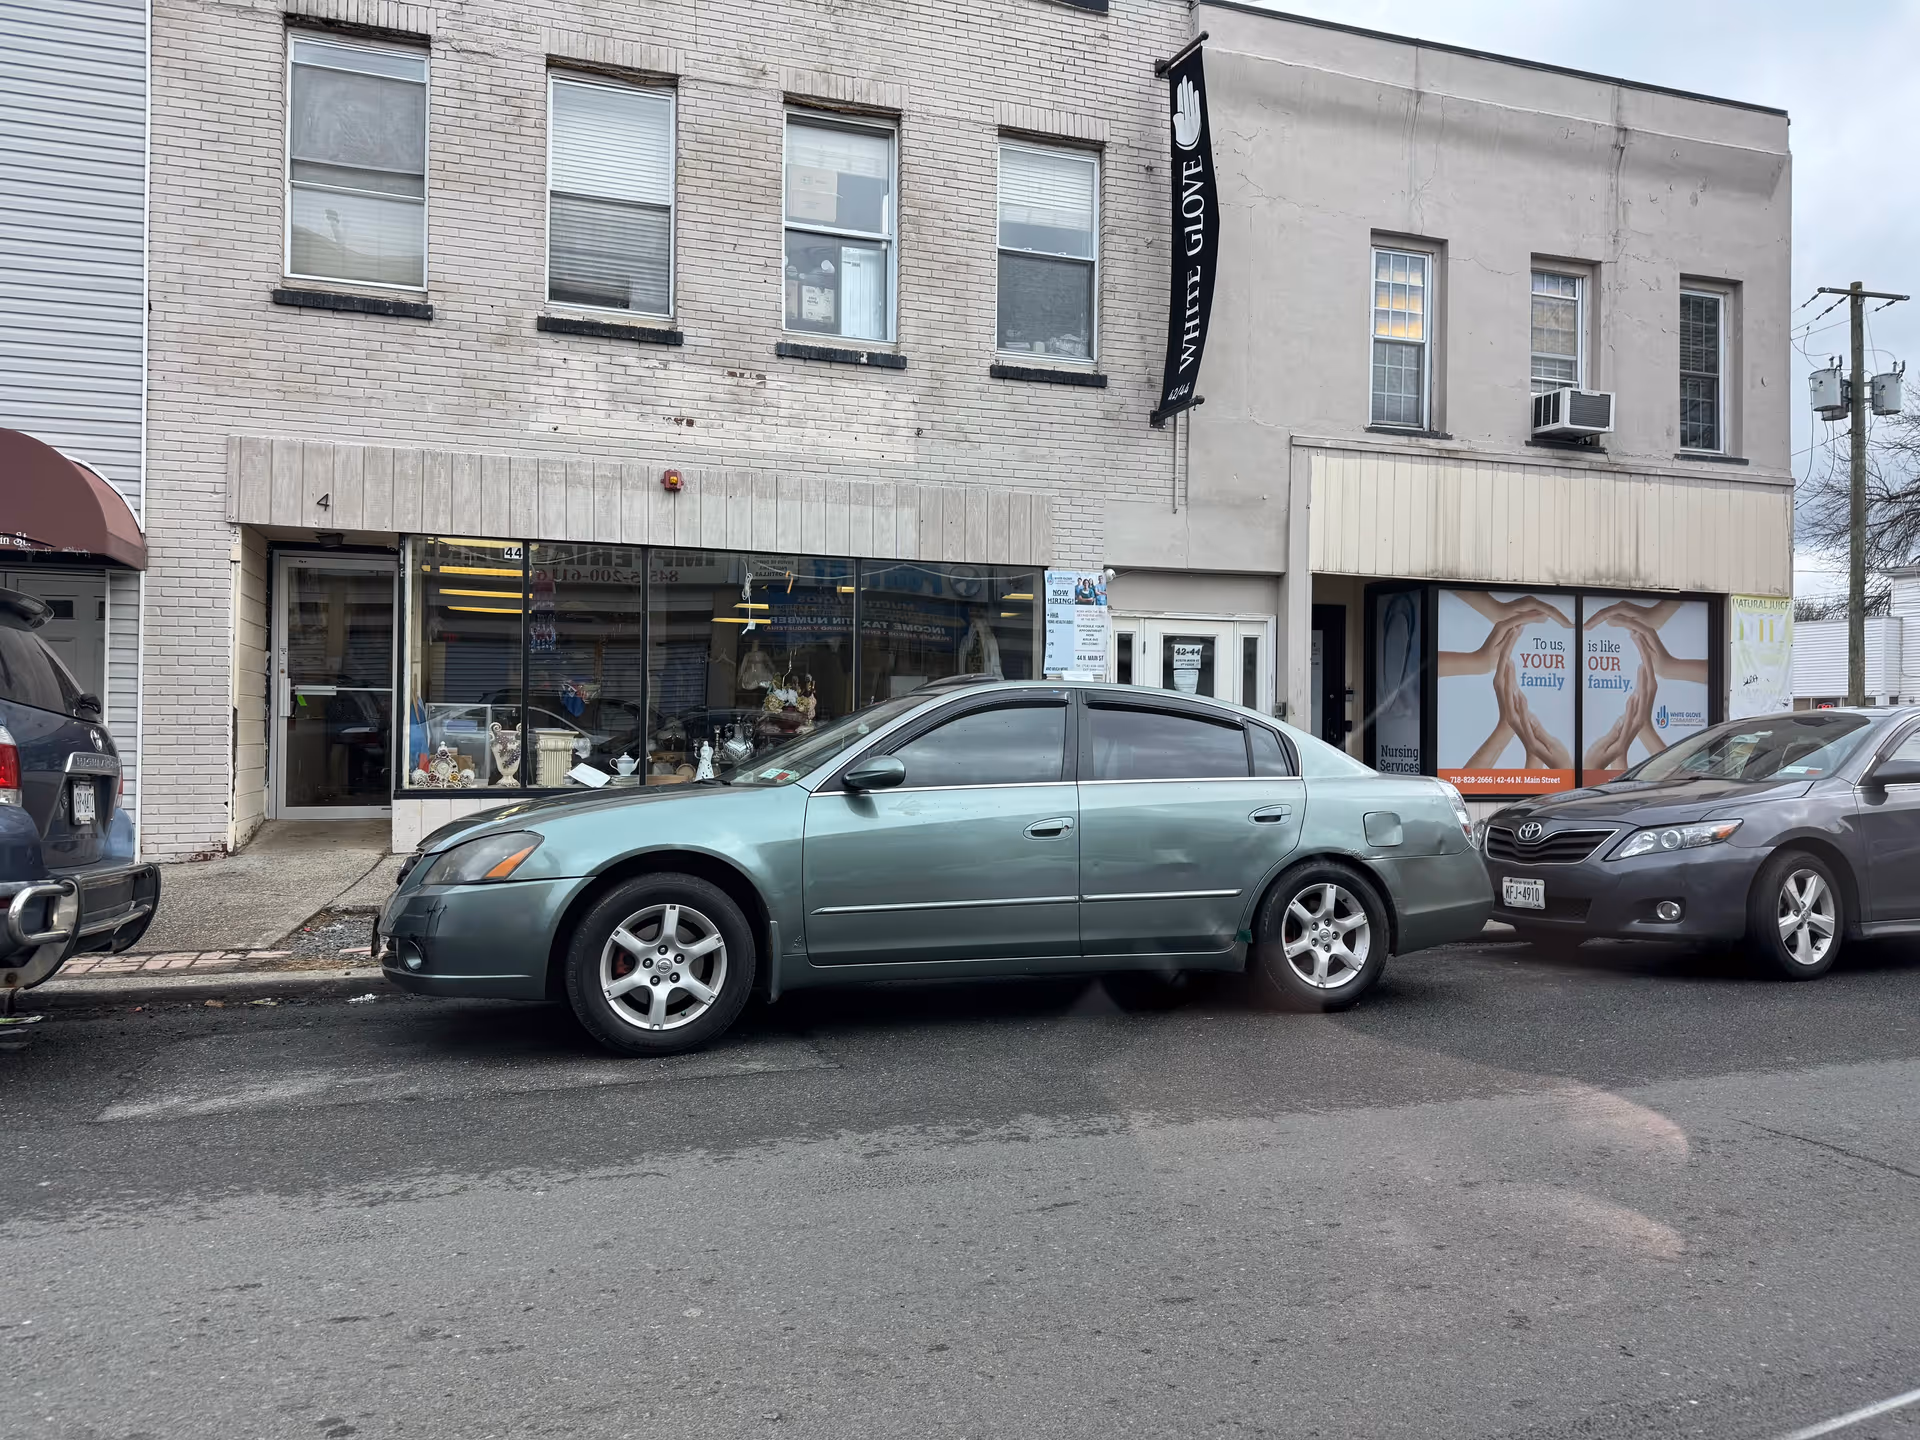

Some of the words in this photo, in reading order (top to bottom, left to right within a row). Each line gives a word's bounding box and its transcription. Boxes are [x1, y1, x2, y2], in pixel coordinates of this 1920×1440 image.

[1181, 155, 1205, 257] GLOVE
[1178, 265, 1201, 375] WHITE
[316, 492, 330, 512] 4
[504, 547, 522, 558] 44
[1047, 597, 1075, 605] HIRING!
[1175, 647, 1201, 656] 42-44
[1533, 637, 1547, 650] To
[1549, 640, 1566, 652] us,
[1588, 640, 1598, 652] is
[1600, 640, 1621, 653] like
[1520, 653, 1565, 669] YOUR
[1588, 656, 1621, 671] OUR
[1521, 672, 1565, 691] family
[1588, 675, 1633, 692] family.
[1380, 744, 1419, 762] Nursing
[1380, 759, 1420, 773] Services
[1450, 776, 1493, 784] 718-828-2666
